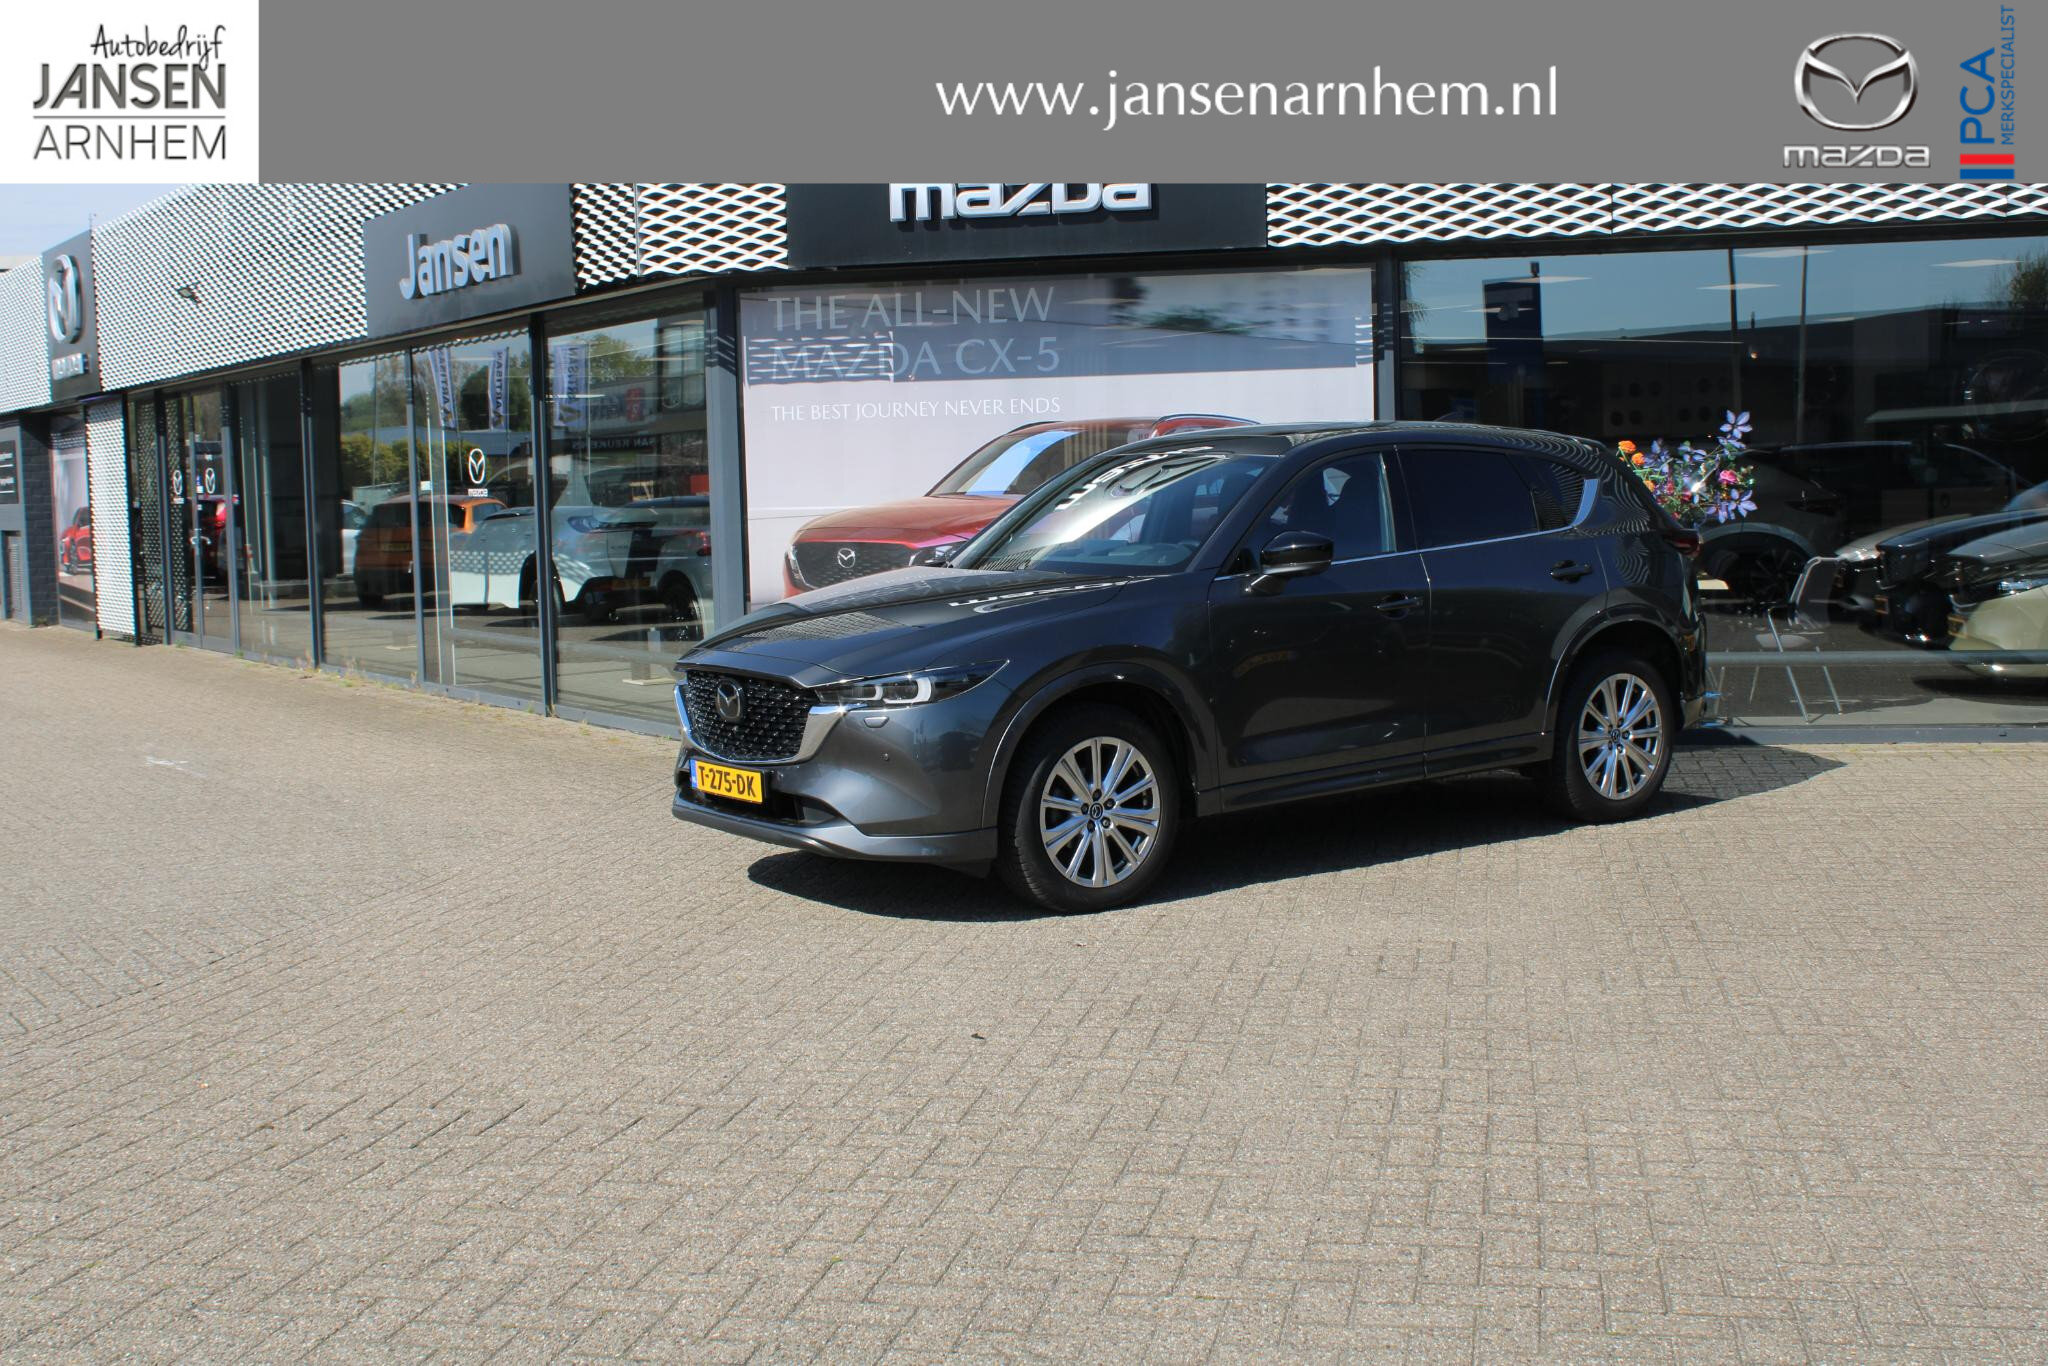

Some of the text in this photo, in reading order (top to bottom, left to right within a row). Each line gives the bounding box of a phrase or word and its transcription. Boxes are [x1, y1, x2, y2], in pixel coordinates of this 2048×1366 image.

[399, 223, 515, 300] Jansen
[767, 286, 1055, 331] THE ALL-NEW
[771, 336, 1060, 379] MAZDA CX-5
[771, 396, 1061, 422] THE BEST JOURNEY NEVER ENDS
[698, 765, 756, 798] T-275-DK
